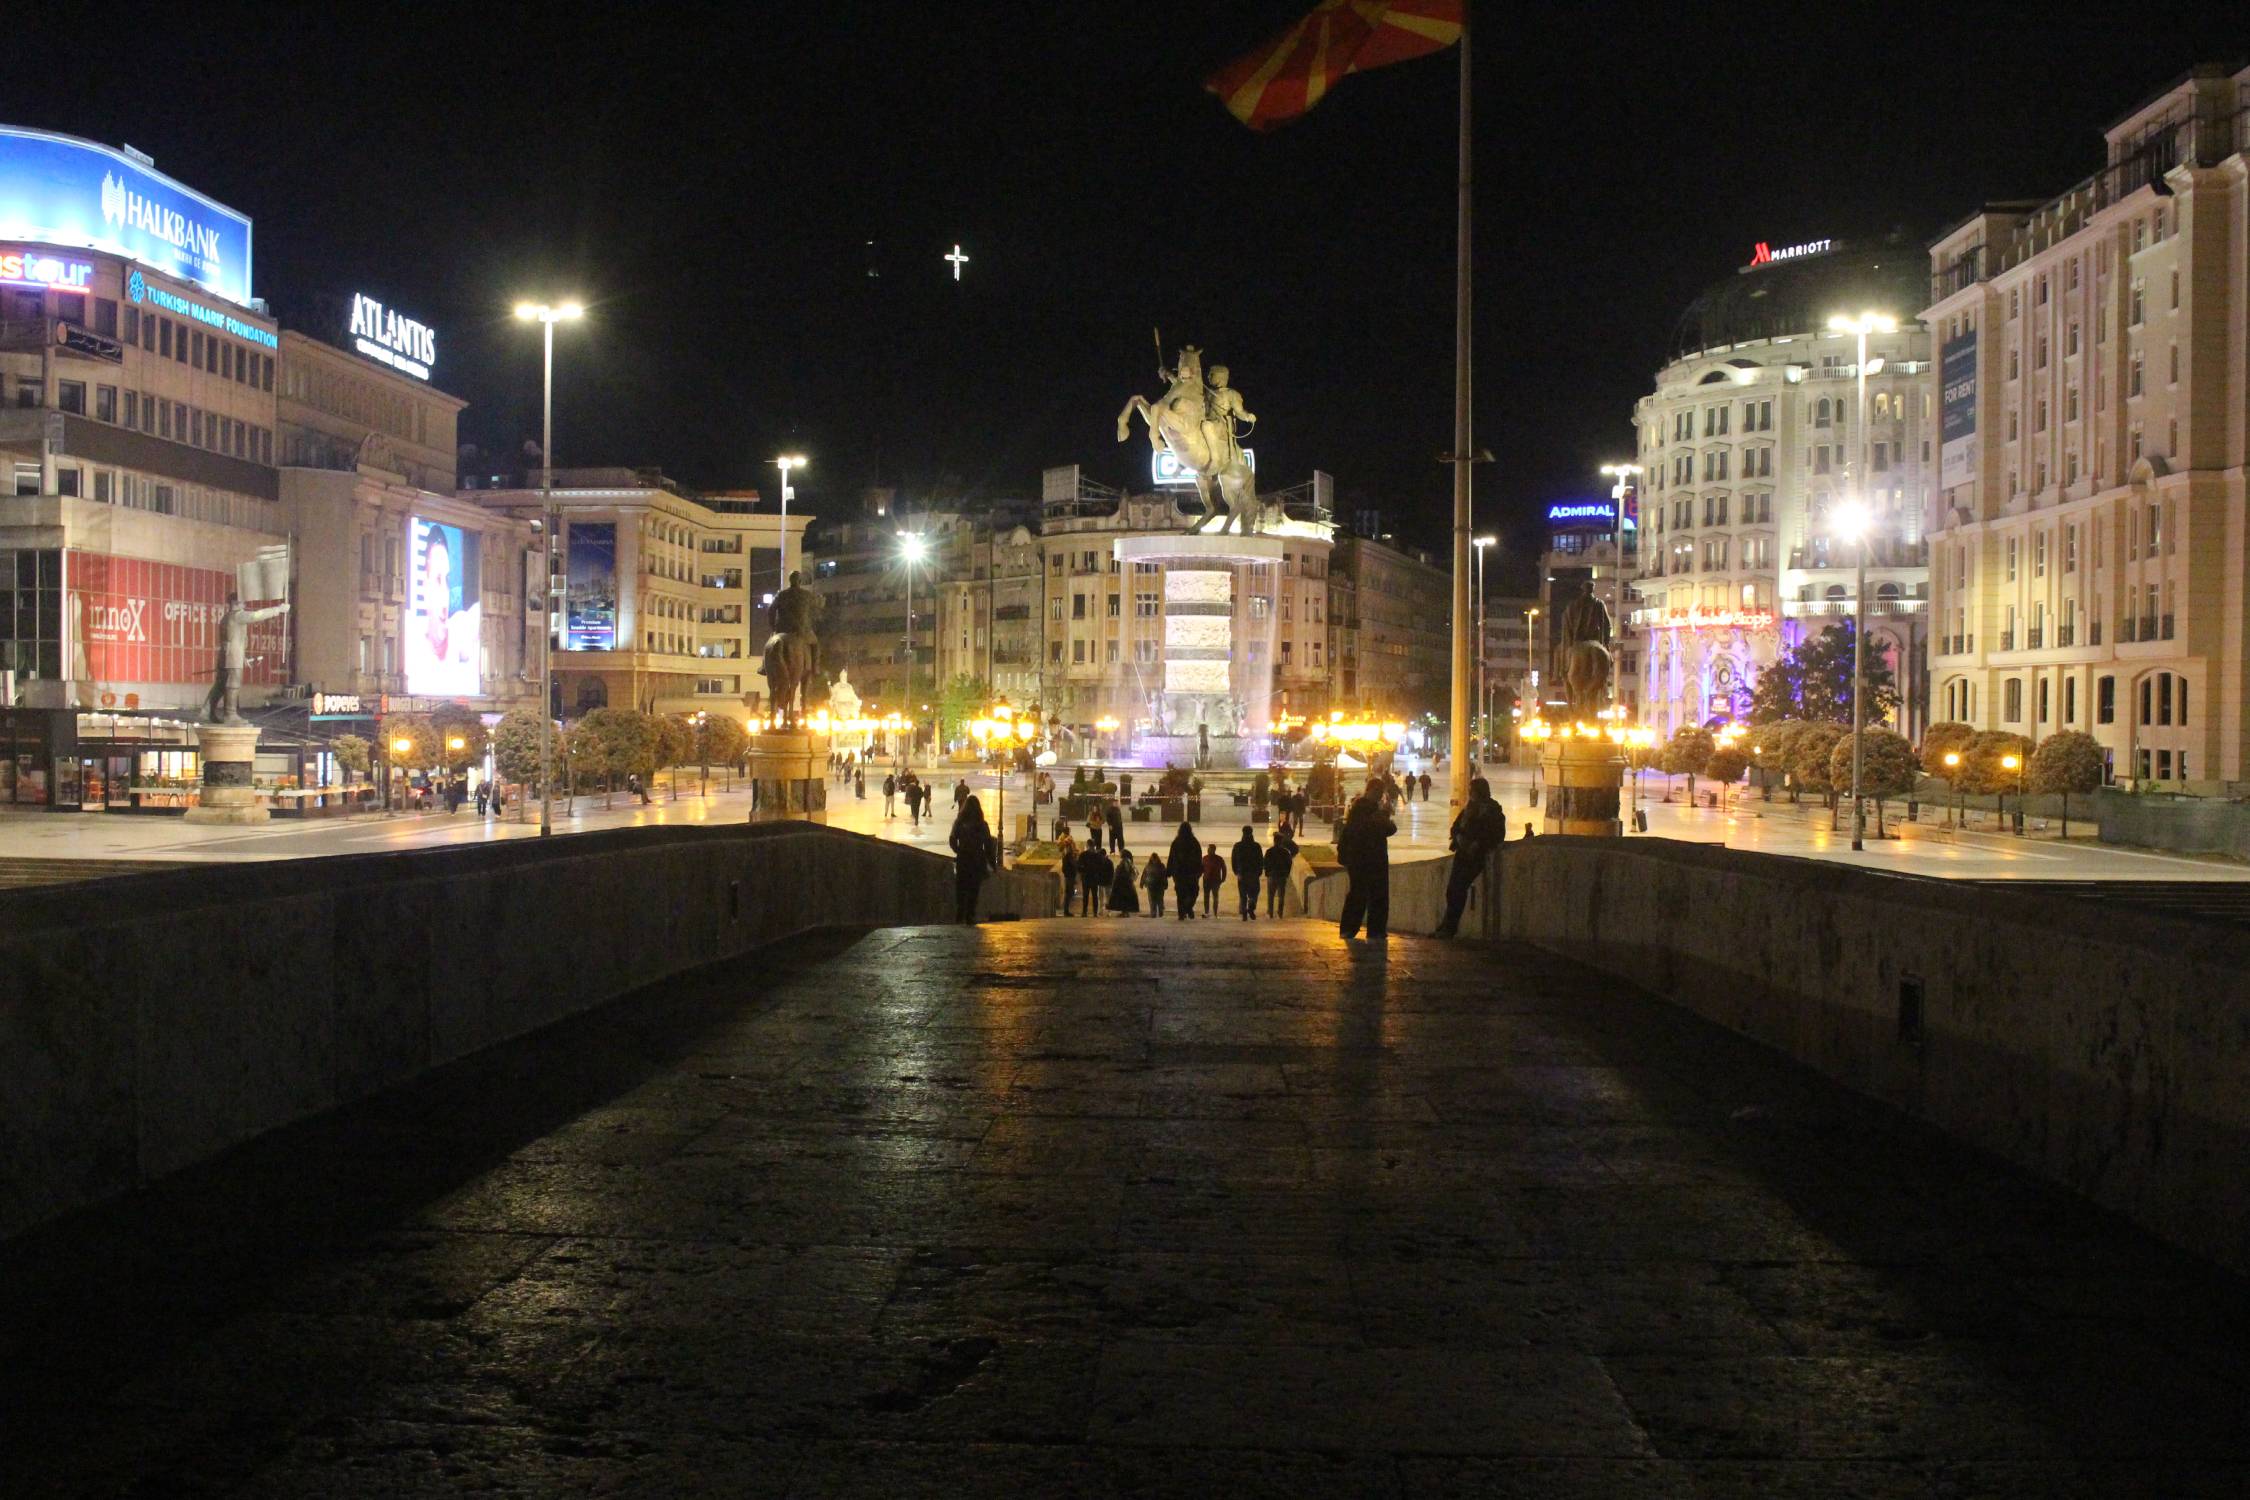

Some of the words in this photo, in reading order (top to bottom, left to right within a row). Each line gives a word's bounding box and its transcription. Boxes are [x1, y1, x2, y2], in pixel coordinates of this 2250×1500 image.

[128, 191, 220, 263] HALKBANK
[1771, 240, 1831, 261] MARRIOTT
[146, 286, 190, 316] TURKISH
[191, 303, 225, 329] MAARIF
[226, 317, 278, 350] FOUNDATION
[350, 292, 435, 366] ATLANTIS
[1958, 379, 1975, 399] RENT
[1549, 504, 1615, 518] ADMIRAL
[164, 602, 207, 625] OFFICE
[324, 695, 360, 713] POPEYES
